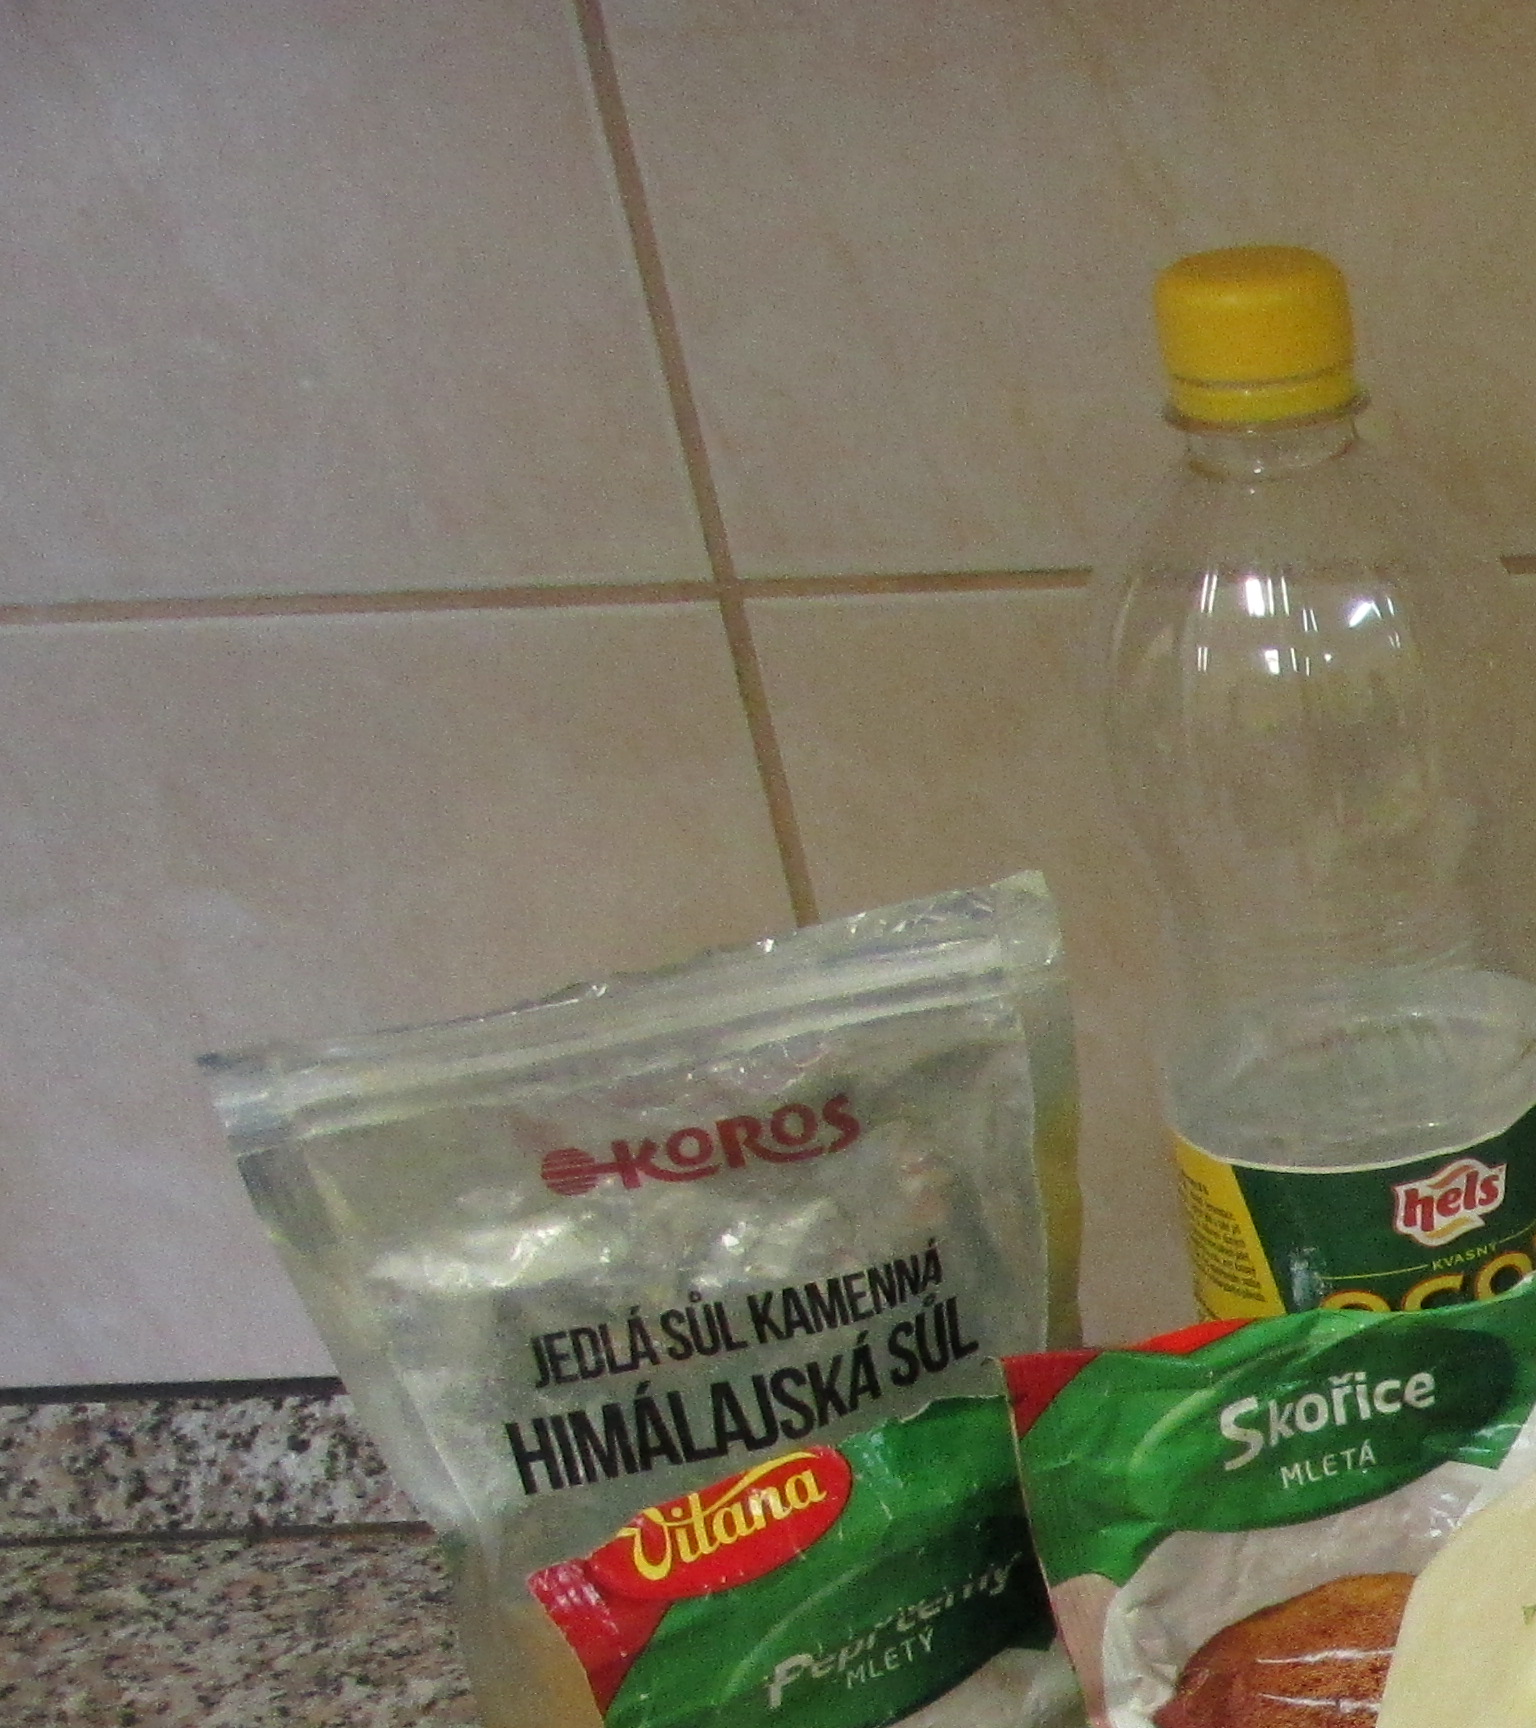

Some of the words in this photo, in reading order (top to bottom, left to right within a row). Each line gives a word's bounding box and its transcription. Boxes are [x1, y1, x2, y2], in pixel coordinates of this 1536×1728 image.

[608, 1093, 861, 1190] KOROS
[1401, 1170, 1500, 1232] hels
[529, 1305, 660, 1388] JEDLÁ
[660, 1291, 748, 1361] SŮL
[747, 1237, 943, 1343] KAMENNÁ
[505, 1331, 882, 1495] HIMÁLAJSKÁ
[887, 1293, 979, 1387] SŮL
[1220, 1371, 1436, 1471] Skořice
[1280, 1439, 1377, 1489] MLETÁ
[616, 1451, 827, 1581] Vitana
